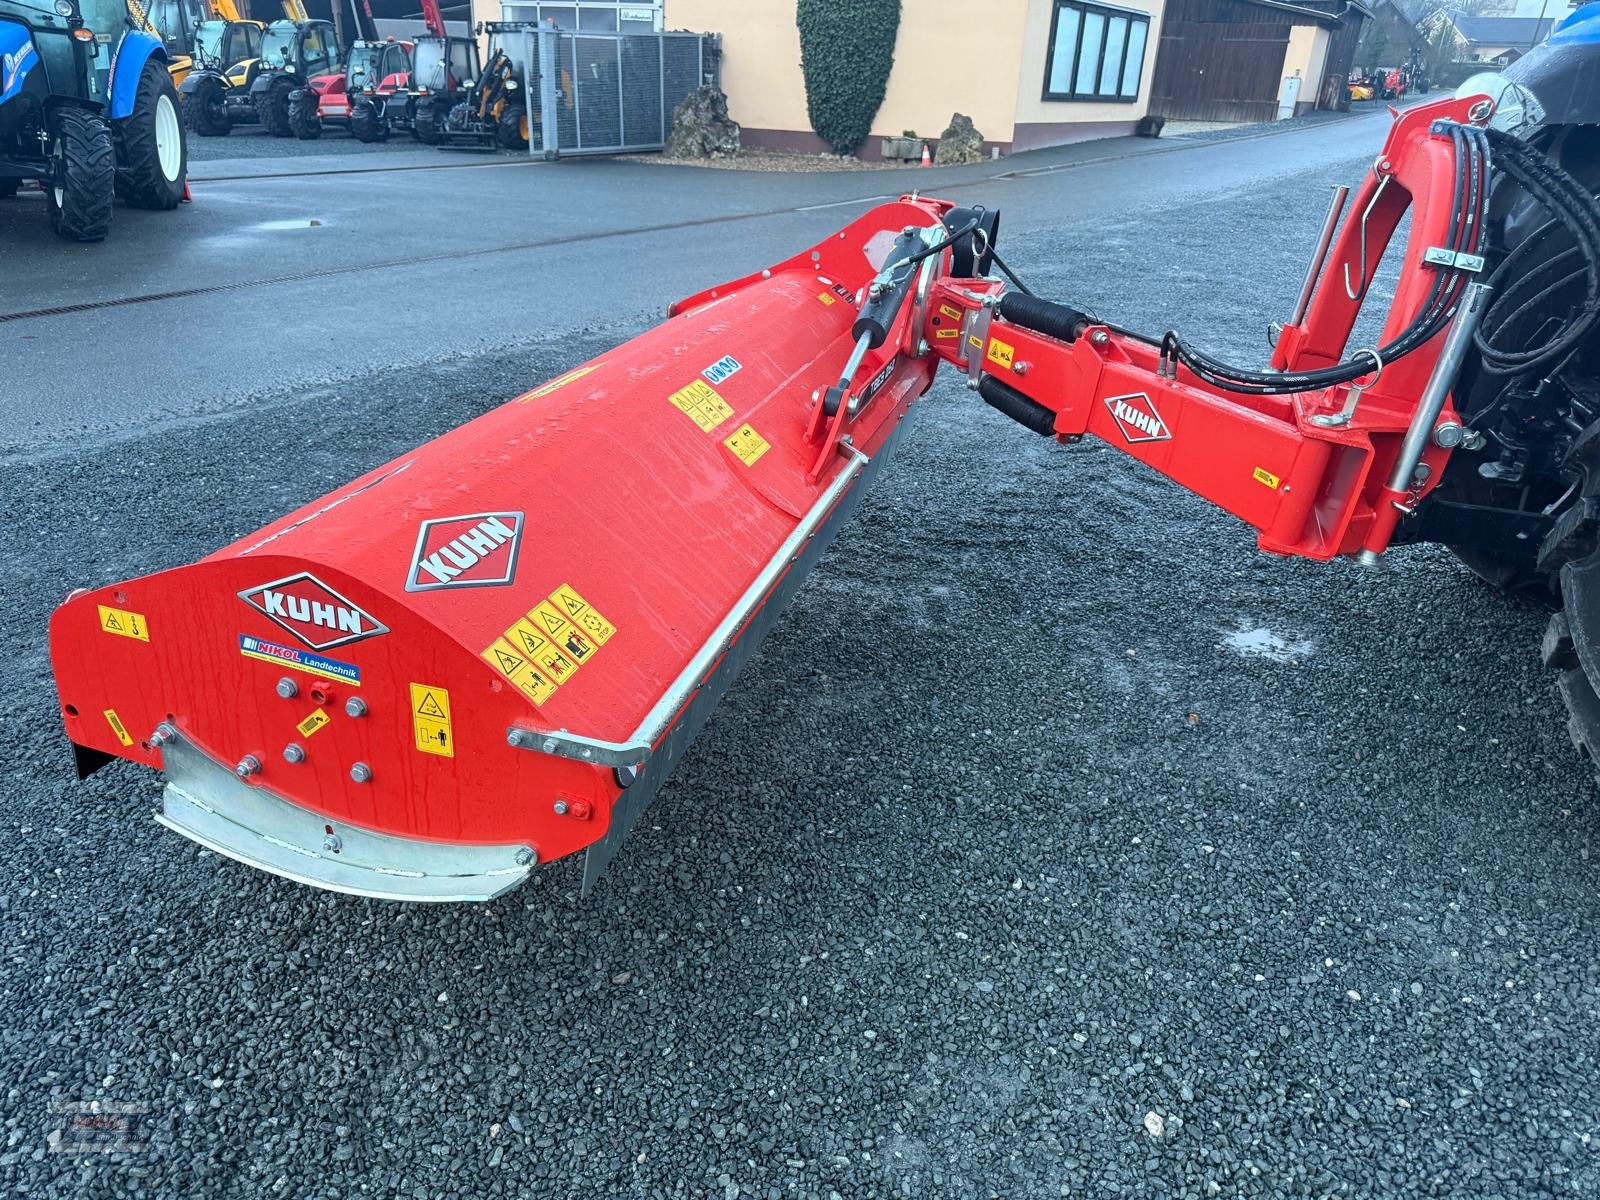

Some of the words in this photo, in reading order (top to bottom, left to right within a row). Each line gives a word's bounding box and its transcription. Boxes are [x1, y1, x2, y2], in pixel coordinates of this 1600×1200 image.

[1114, 399, 1161, 437] KUHN
[418, 516, 516, 584] KUHN
[263, 589, 362, 635] KUHN
[598, 627, 610, 639] STOP
[257, 642, 302, 663] NIKOL
[304, 656, 357, 678] Landtechnik
